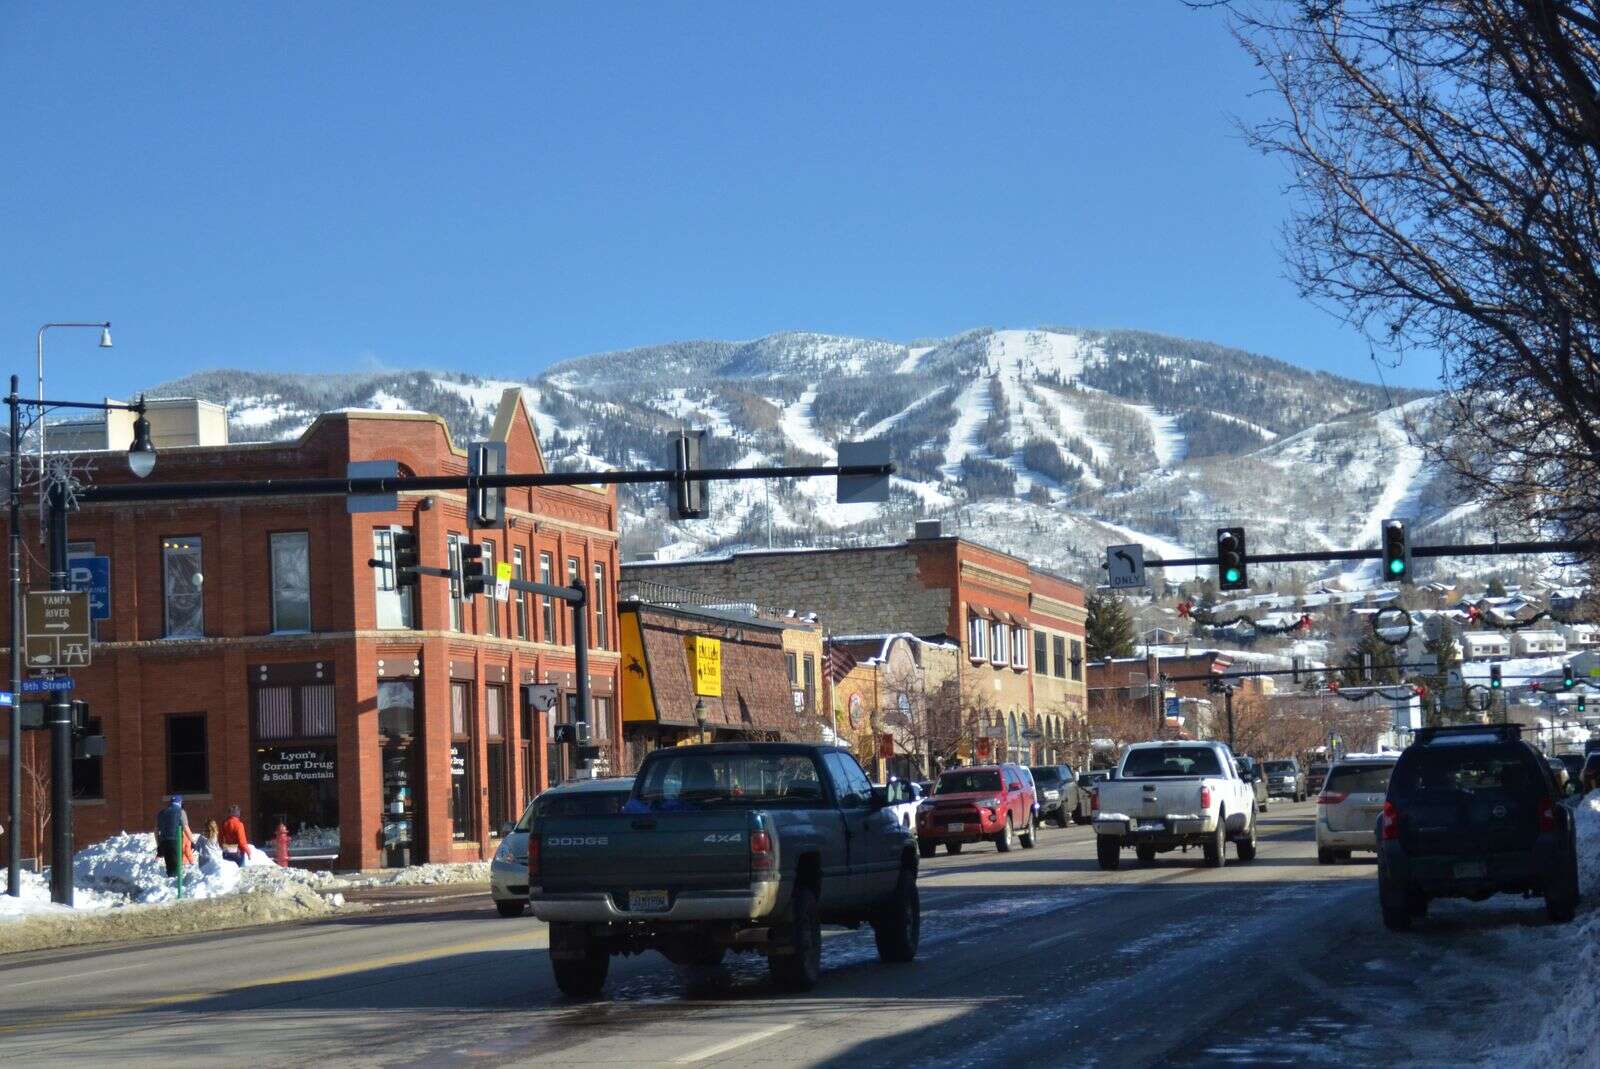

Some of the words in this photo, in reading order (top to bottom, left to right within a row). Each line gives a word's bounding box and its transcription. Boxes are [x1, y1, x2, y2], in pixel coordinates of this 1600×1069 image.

[1114, 575, 1140, 585] ONLY
[43, 595, 71, 605] YAMPA
[45, 608, 70, 618] RIVER
[22, 681, 39, 691] 9th
[41, 680, 72, 690] Street
[281, 750, 316, 761] Lyon's
[262, 762, 301, 771] Corner
[304, 760, 335, 770] Drug
[262, 773, 271, 781] &
[272, 772, 294, 781] Soda
[295, 770, 335, 780] Fountain
[548, 836, 609, 846] DODGE
